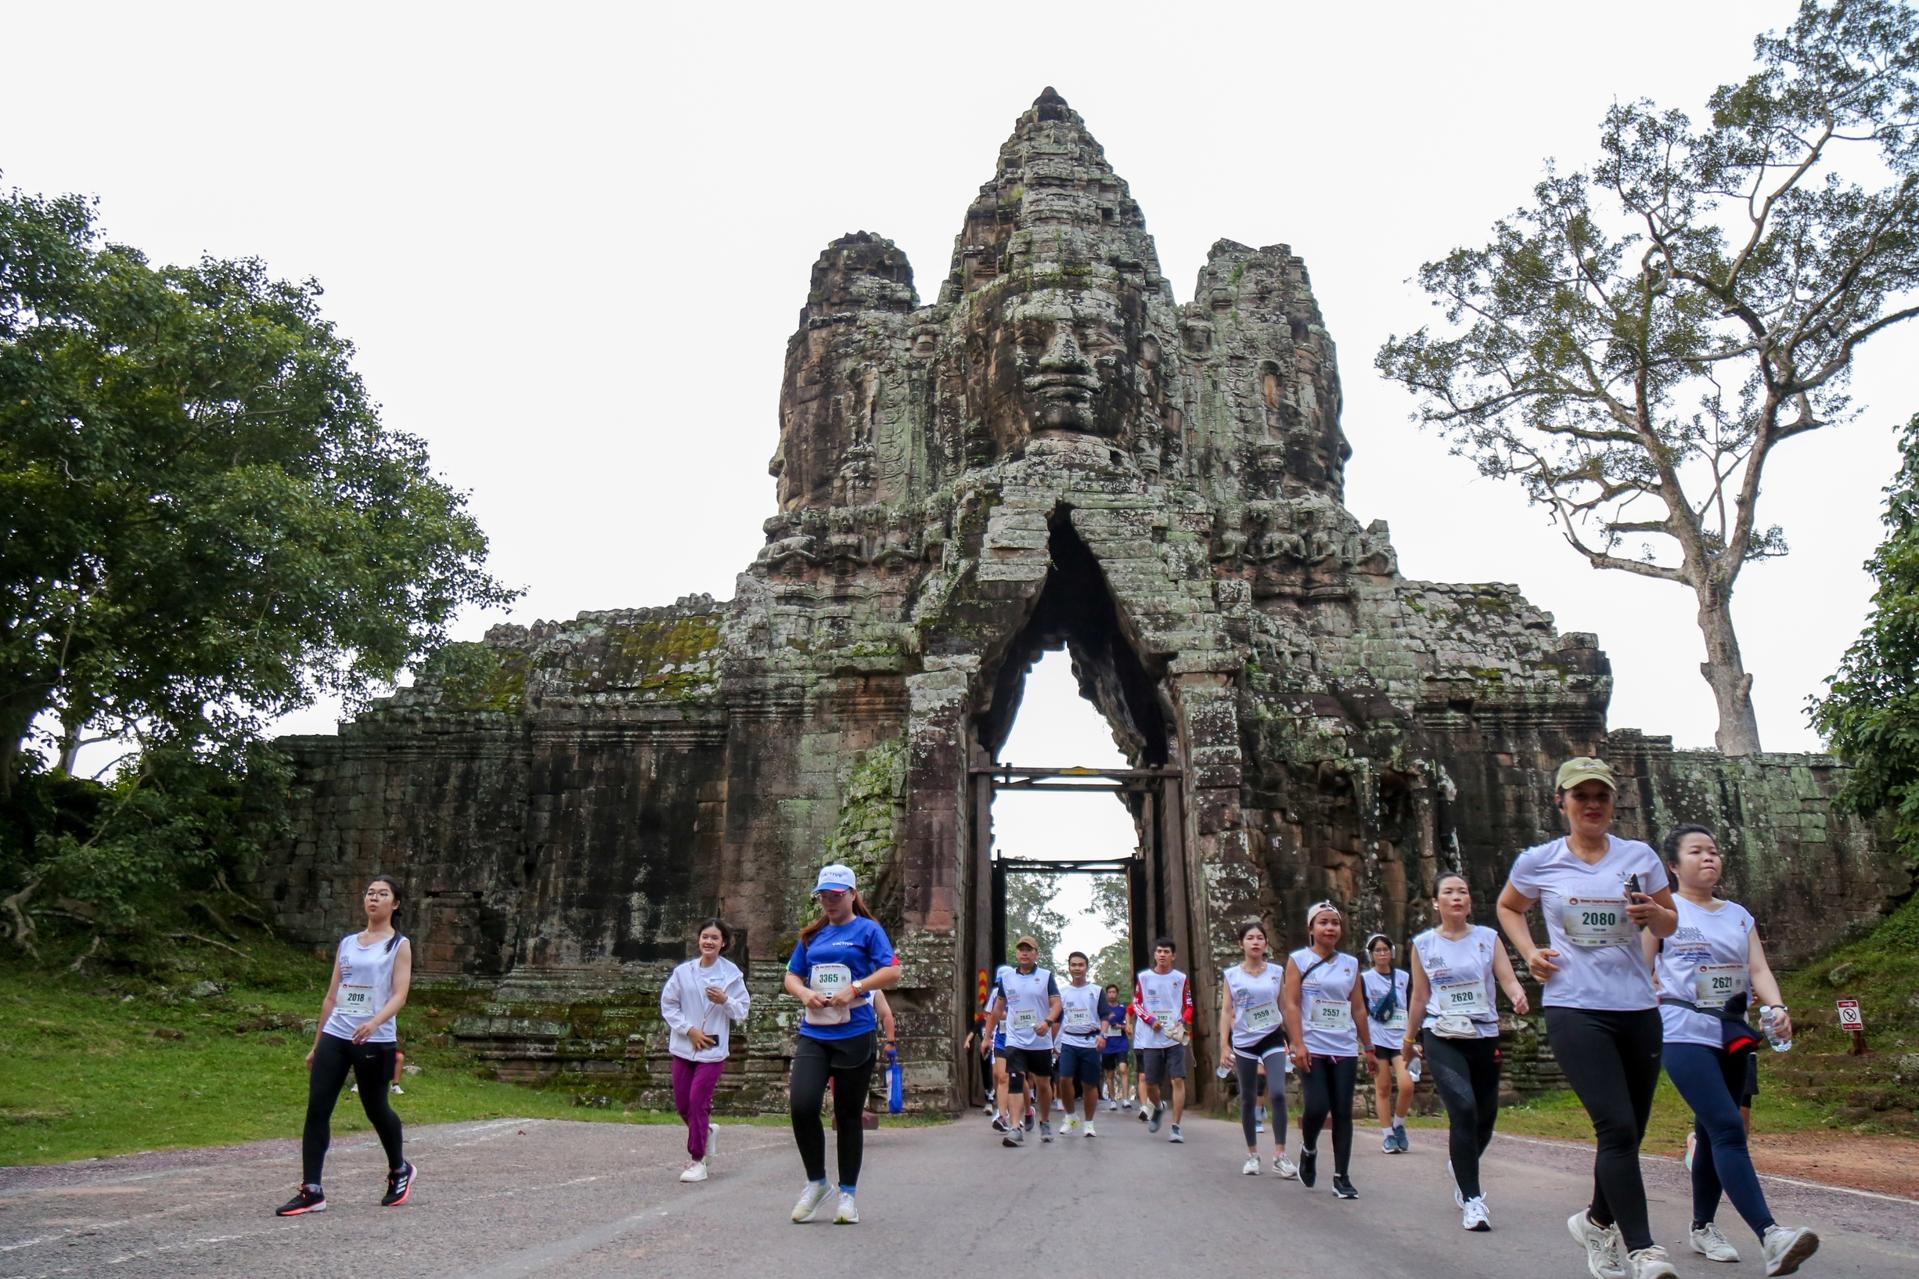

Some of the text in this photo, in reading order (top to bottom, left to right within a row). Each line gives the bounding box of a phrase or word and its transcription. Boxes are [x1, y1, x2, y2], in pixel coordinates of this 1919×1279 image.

[1582, 912, 1616, 926] 2080
[819, 973, 839, 983] 3365
[1712, 976, 1733, 988] 2621
[347, 993, 365, 1002] 2018
[1451, 991, 1473, 1003] 2620
[1253, 1009, 1270, 1020] 2559
[1322, 1008, 1340, 1017] 2557
